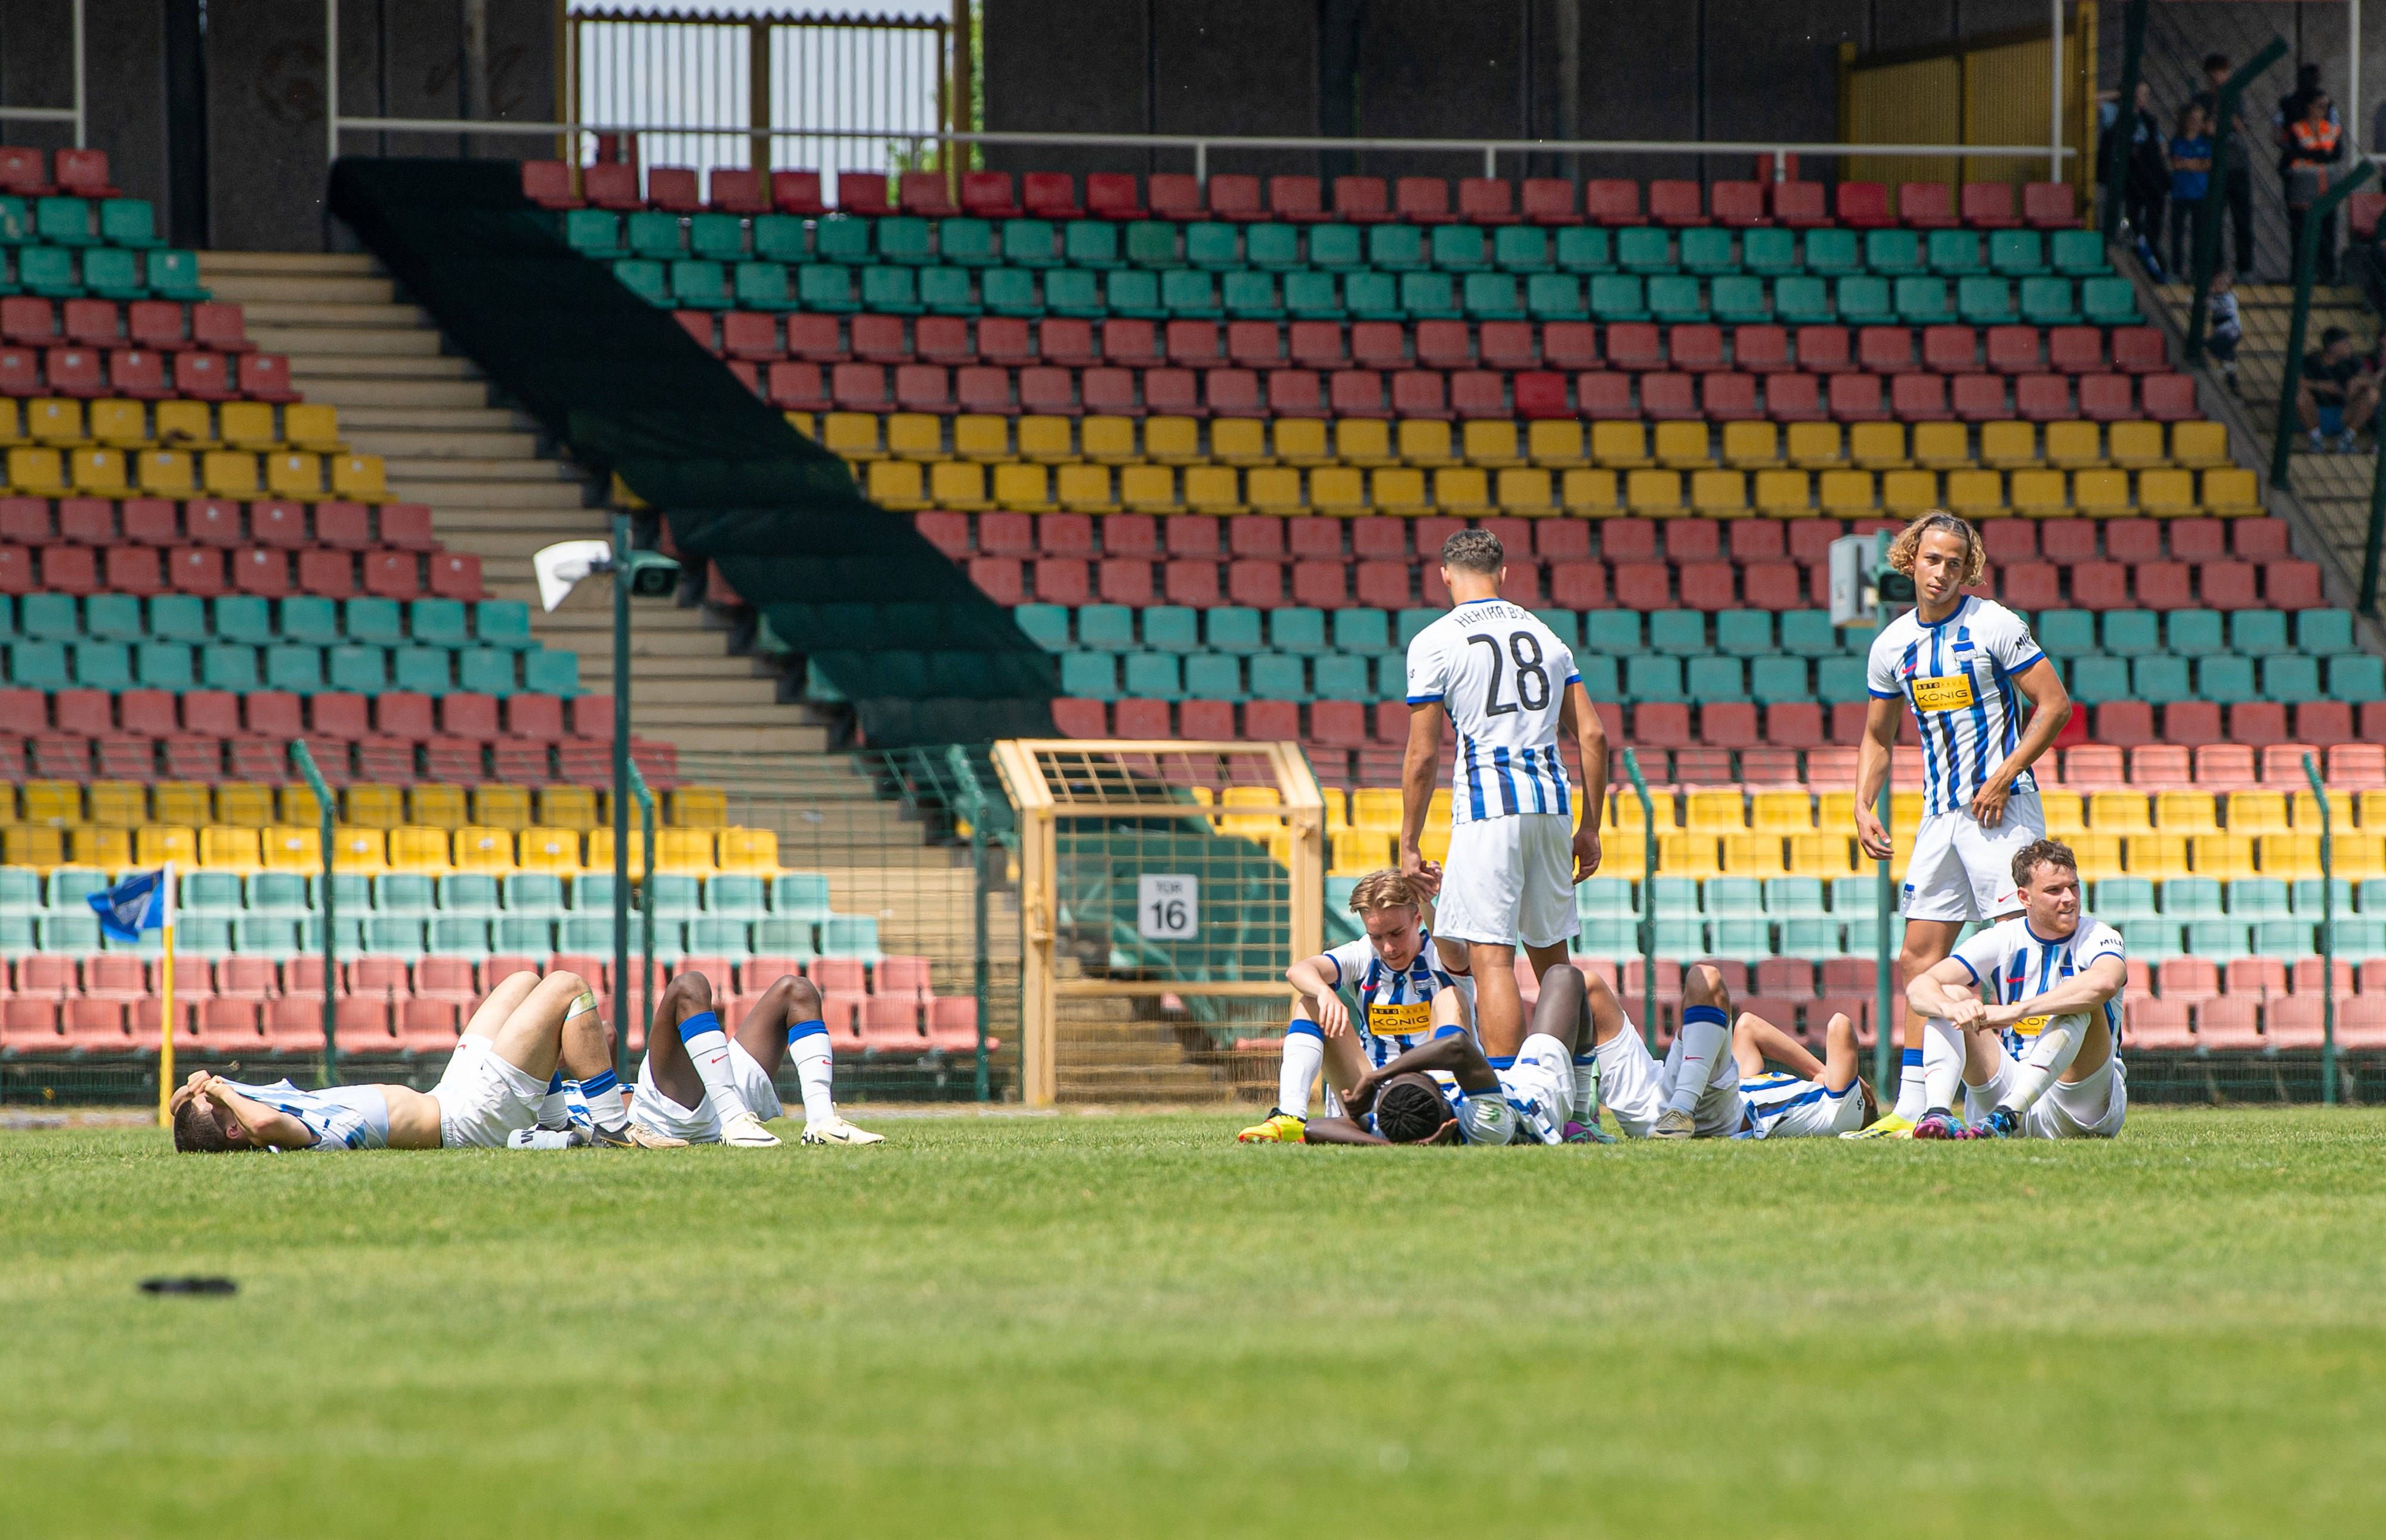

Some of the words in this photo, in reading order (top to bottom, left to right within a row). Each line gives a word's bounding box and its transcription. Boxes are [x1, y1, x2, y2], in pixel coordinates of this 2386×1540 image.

[1507, 607, 1532, 621] BSC
[1467, 630, 1550, 718] 28
[1918, 689, 1968, 702] KÖNIG
[1156, 881, 1183, 893] TOR
[1149, 899, 1186, 930] 16
[1373, 1015, 1429, 1026] KÖNIG
